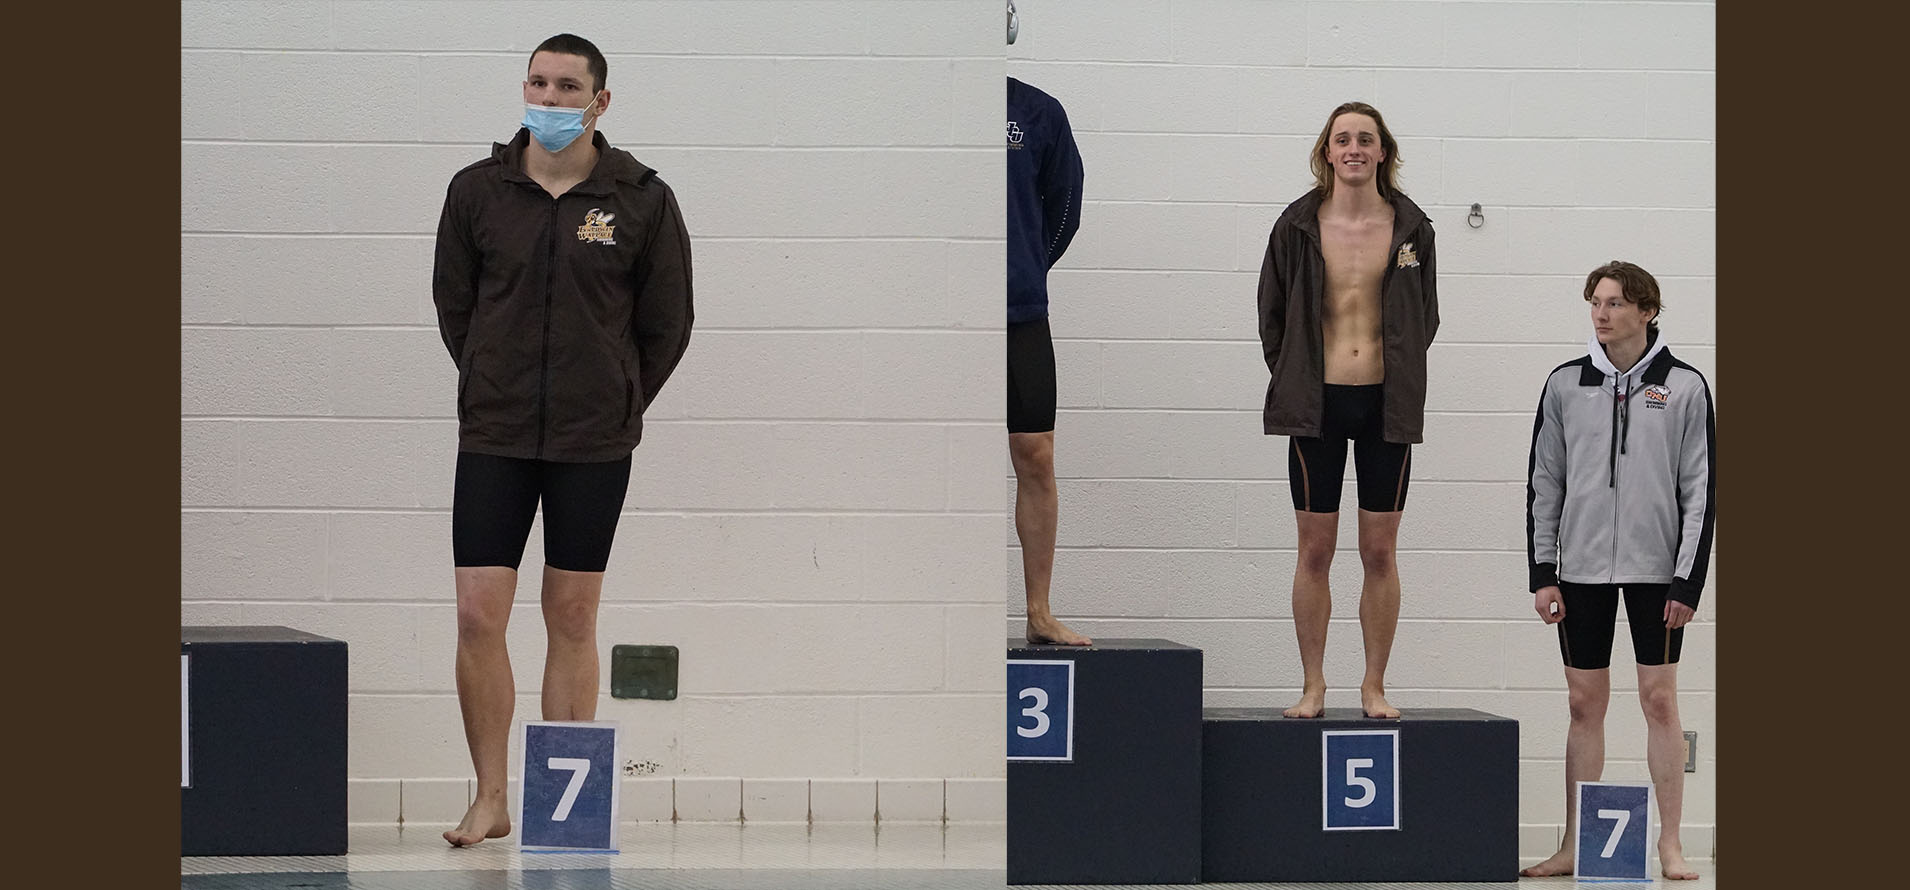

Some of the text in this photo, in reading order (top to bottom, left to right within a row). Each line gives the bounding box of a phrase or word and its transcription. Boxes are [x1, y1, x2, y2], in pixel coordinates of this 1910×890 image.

[1017, 687, 1050, 738] 3
[547, 757, 591, 822] 7
[1344, 758, 1376, 808] 5
[1597, 809, 1631, 858] 7
